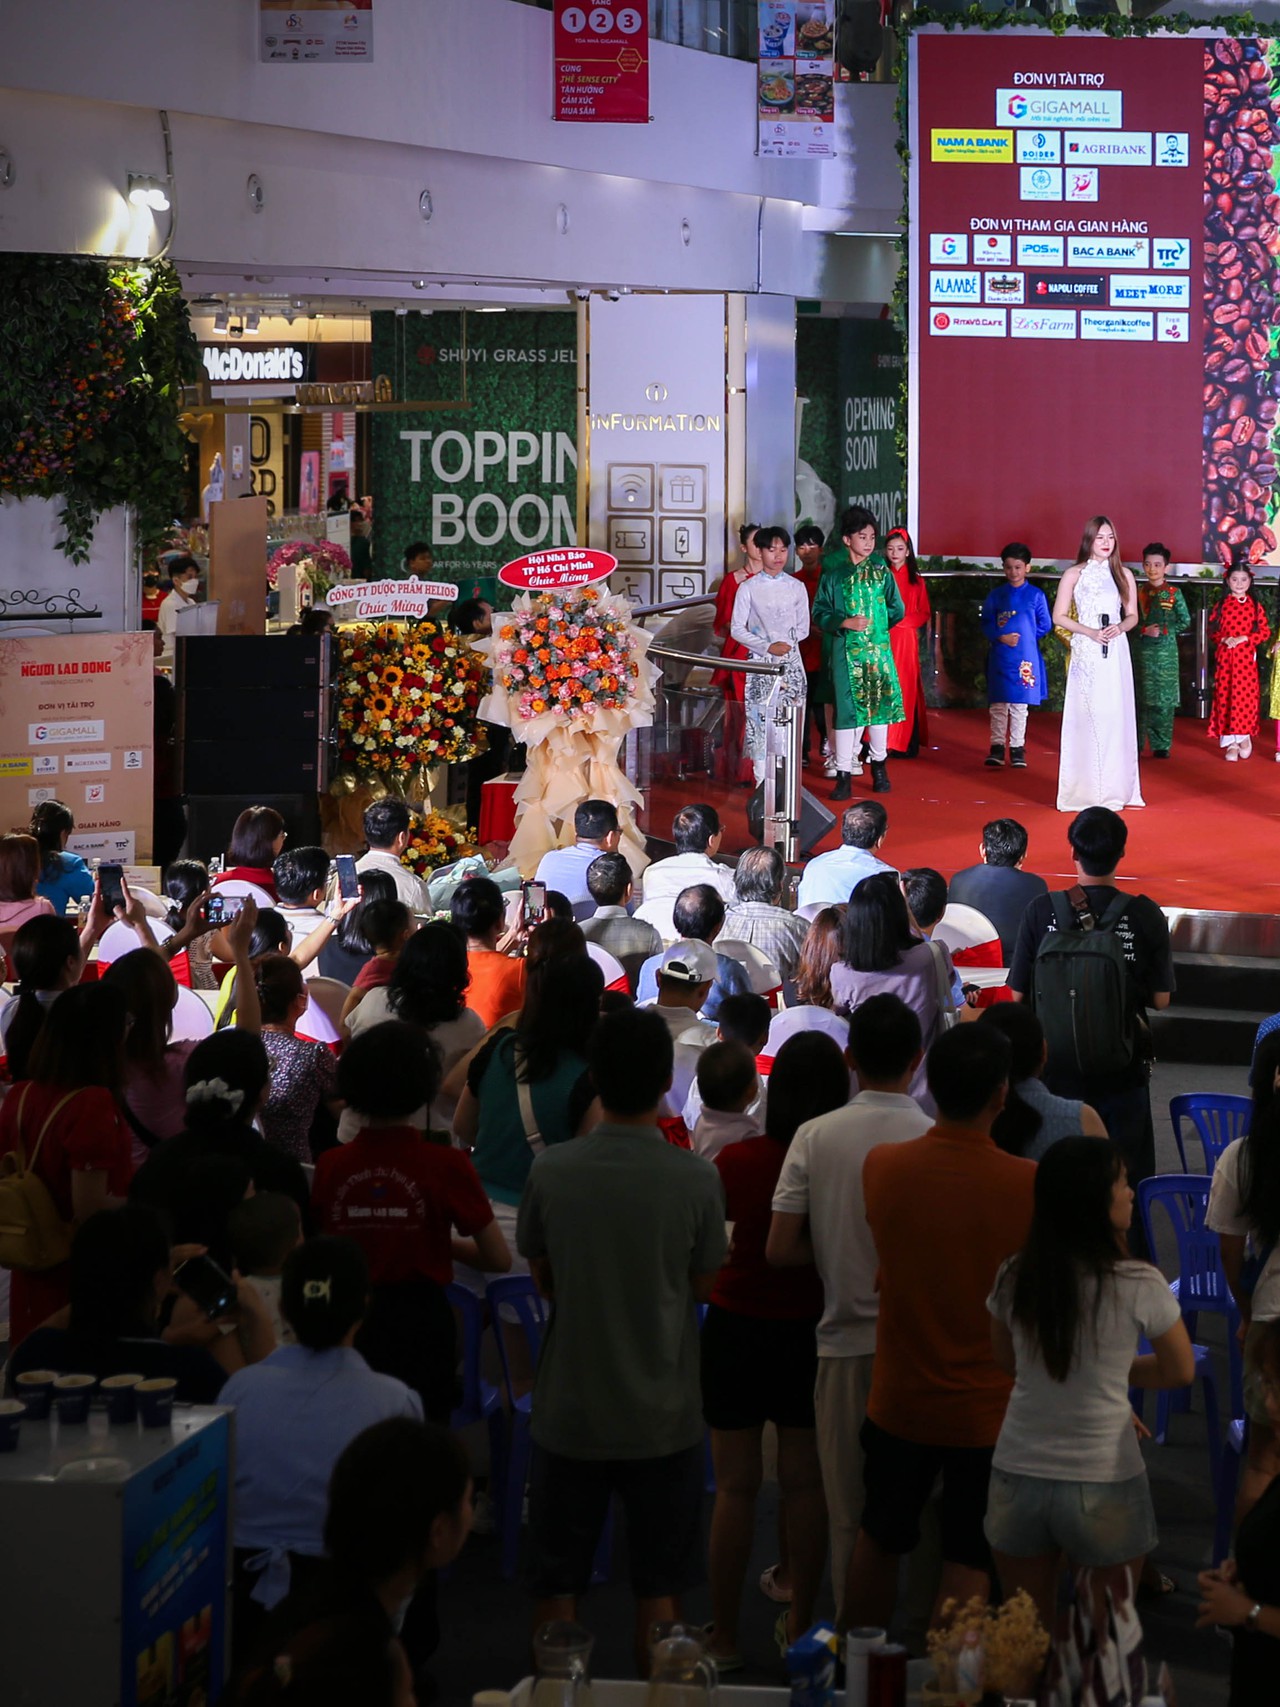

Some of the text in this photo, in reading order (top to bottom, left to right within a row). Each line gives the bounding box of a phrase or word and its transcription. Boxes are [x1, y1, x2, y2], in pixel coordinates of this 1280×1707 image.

[569, 13, 634, 28] 1 2 3
[577, 76, 600, 84] SENSE
[601, 76, 619, 84] CITY
[1014, 71, 1105, 88] ĐƠN VỊ TÀI TRỢ
[560, 107, 578, 115] MUA
[1030, 100, 1110, 116] GIGAMALL
[937, 138, 1008, 148] NAM A BANK
[1082, 144, 1147, 156] AGRIBANK
[970, 218, 1148, 234] ĐƠN VỊ THAM GIA GIAN HÀNG
[1073, 246, 1136, 257] BAC A BANK
[1158, 248, 1180, 261] TTC
[934, 276, 977, 294] ALAMBÉ
[1048, 283, 1099, 294] NAPOLI COFFEE
[1116, 285, 1183, 299] MEET MORE
[438, 349, 487, 363] SHUYI
[493, 349, 546, 363] GRASS
[203, 347, 304, 381] McDonald's
[845, 396, 896, 432] OPENING
[846, 435, 878, 472] SOON
[528, 550, 586, 566] Hội Nhà Báo
[444, 561, 460, 569] FOR
[472, 561, 498, 570] YEARS
[522, 566, 534, 577] TP
[552, 562, 570, 574] Chí
[572, 560, 594, 572] Minh
[528, 573, 556, 587] Chúc
[357, 586, 370, 598] TY
[424, 584, 457, 599] HELIOS
[358, 599, 392, 616] Chúc
[58, 662, 79, 676] LAO
[38, 701, 56, 711] ĐƠN
[49, 726, 97, 737] GIGAMALL
[78, 821, 98, 830] GIAN
